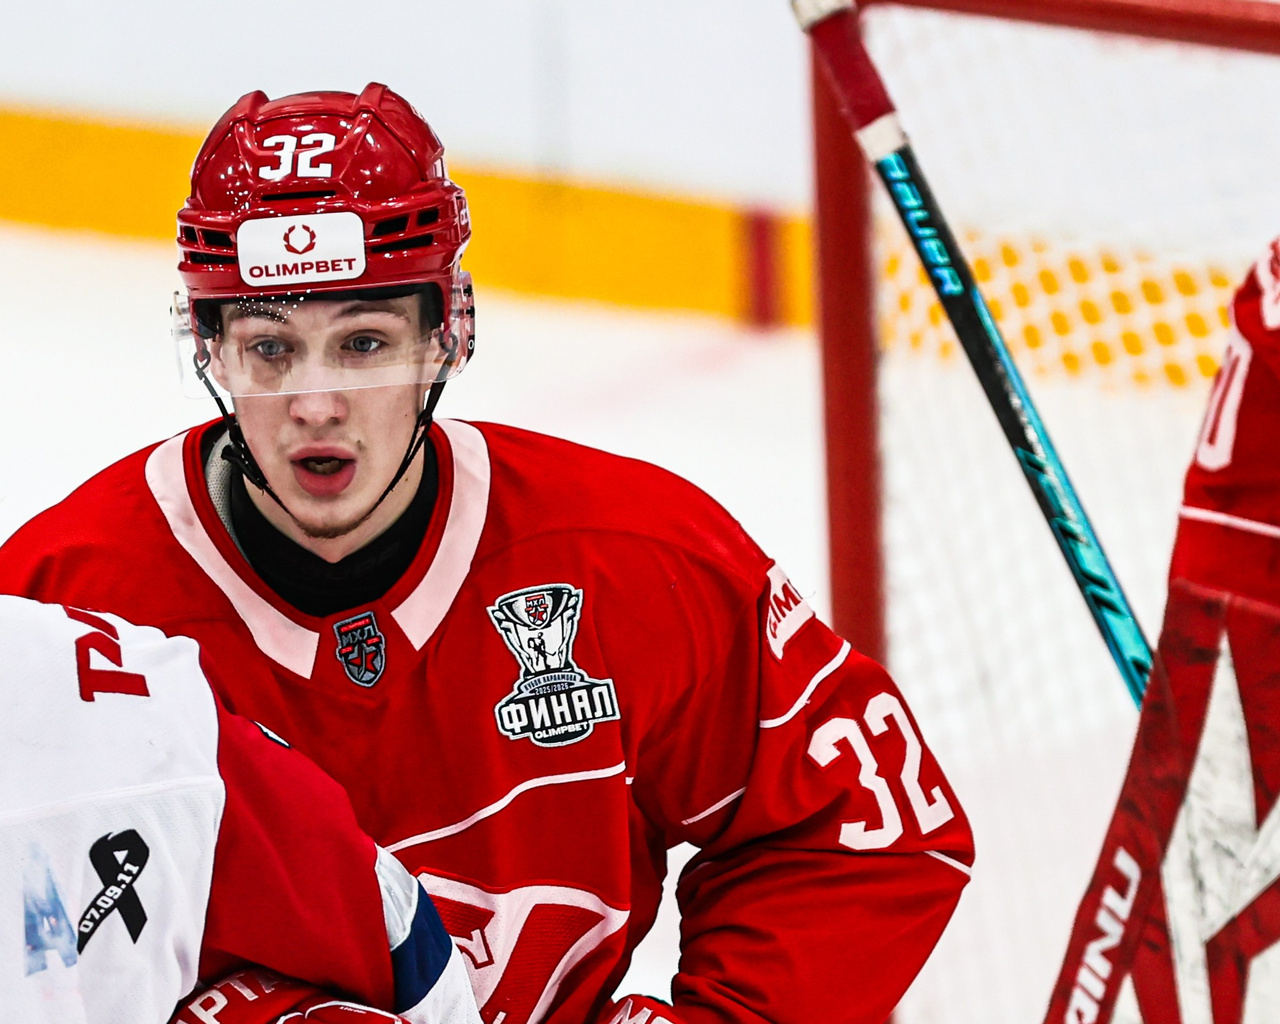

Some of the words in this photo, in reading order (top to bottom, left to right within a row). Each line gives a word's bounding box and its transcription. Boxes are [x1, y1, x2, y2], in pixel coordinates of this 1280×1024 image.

[257, 132, 336, 181] 32
[248, 257, 356, 278] OLIMPBET
[501, 685, 614, 733] ФИНАЛ
[534, 721, 589, 739] OLIMPBET
[807, 691, 955, 850] 32
[79, 862, 140, 934] 07.09.11
